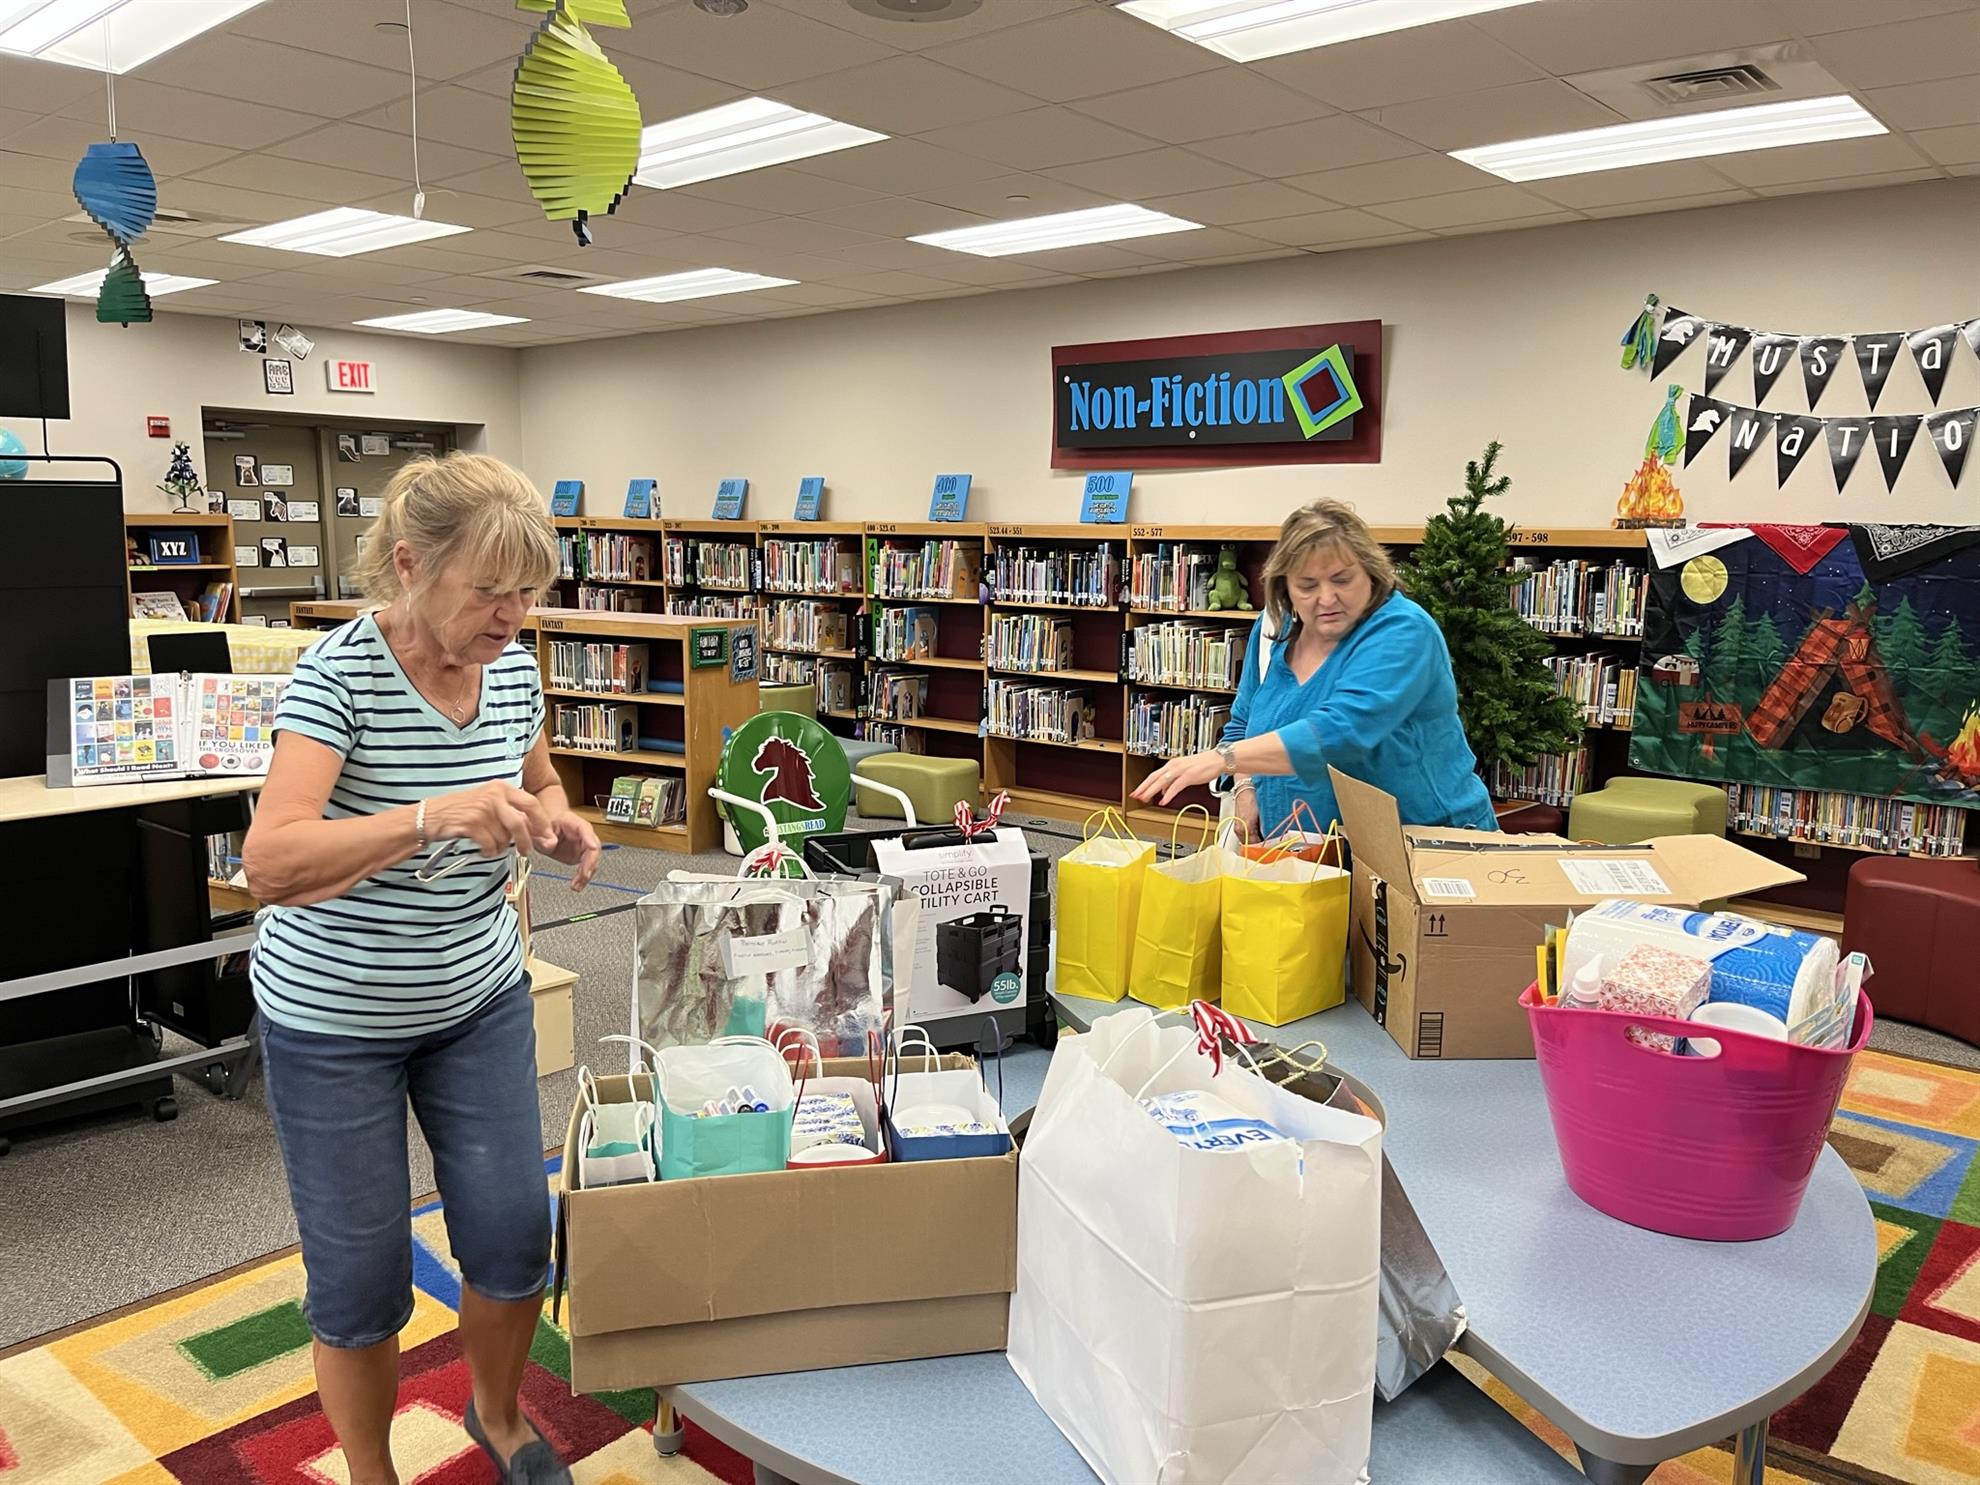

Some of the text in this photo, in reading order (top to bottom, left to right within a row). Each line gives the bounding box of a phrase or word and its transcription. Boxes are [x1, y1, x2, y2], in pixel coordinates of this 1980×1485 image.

[268, 364, 289, 376] ARE
[338, 361, 369, 389] EXIT
[1070, 371, 1285, 431] Non-Fiction
[936, 477, 957, 494] 400
[1087, 475, 1115, 493] 500
[989, 526, 1008, 535] 523.44
[1012, 527, 1022, 535] 551
[1133, 528, 1145, 537] 552
[1150, 528, 1163, 537] 577
[1531, 532, 1549, 544] 598
[160, 541, 188, 557] XYZ
[541, 619, 564, 630] FANTASY
[212, 740, 236, 748] YOU
[240, 741, 270, 750] LIKED
[100, 766, 126, 774] Should
[131, 764, 151, 772] Read
[923, 865, 988, 882] TOTE & GO
[911, 877, 999, 896] COLLAPSIBLE
[920, 890, 999, 910] TILITY CART
[993, 979, 1019, 992] 55lb.
